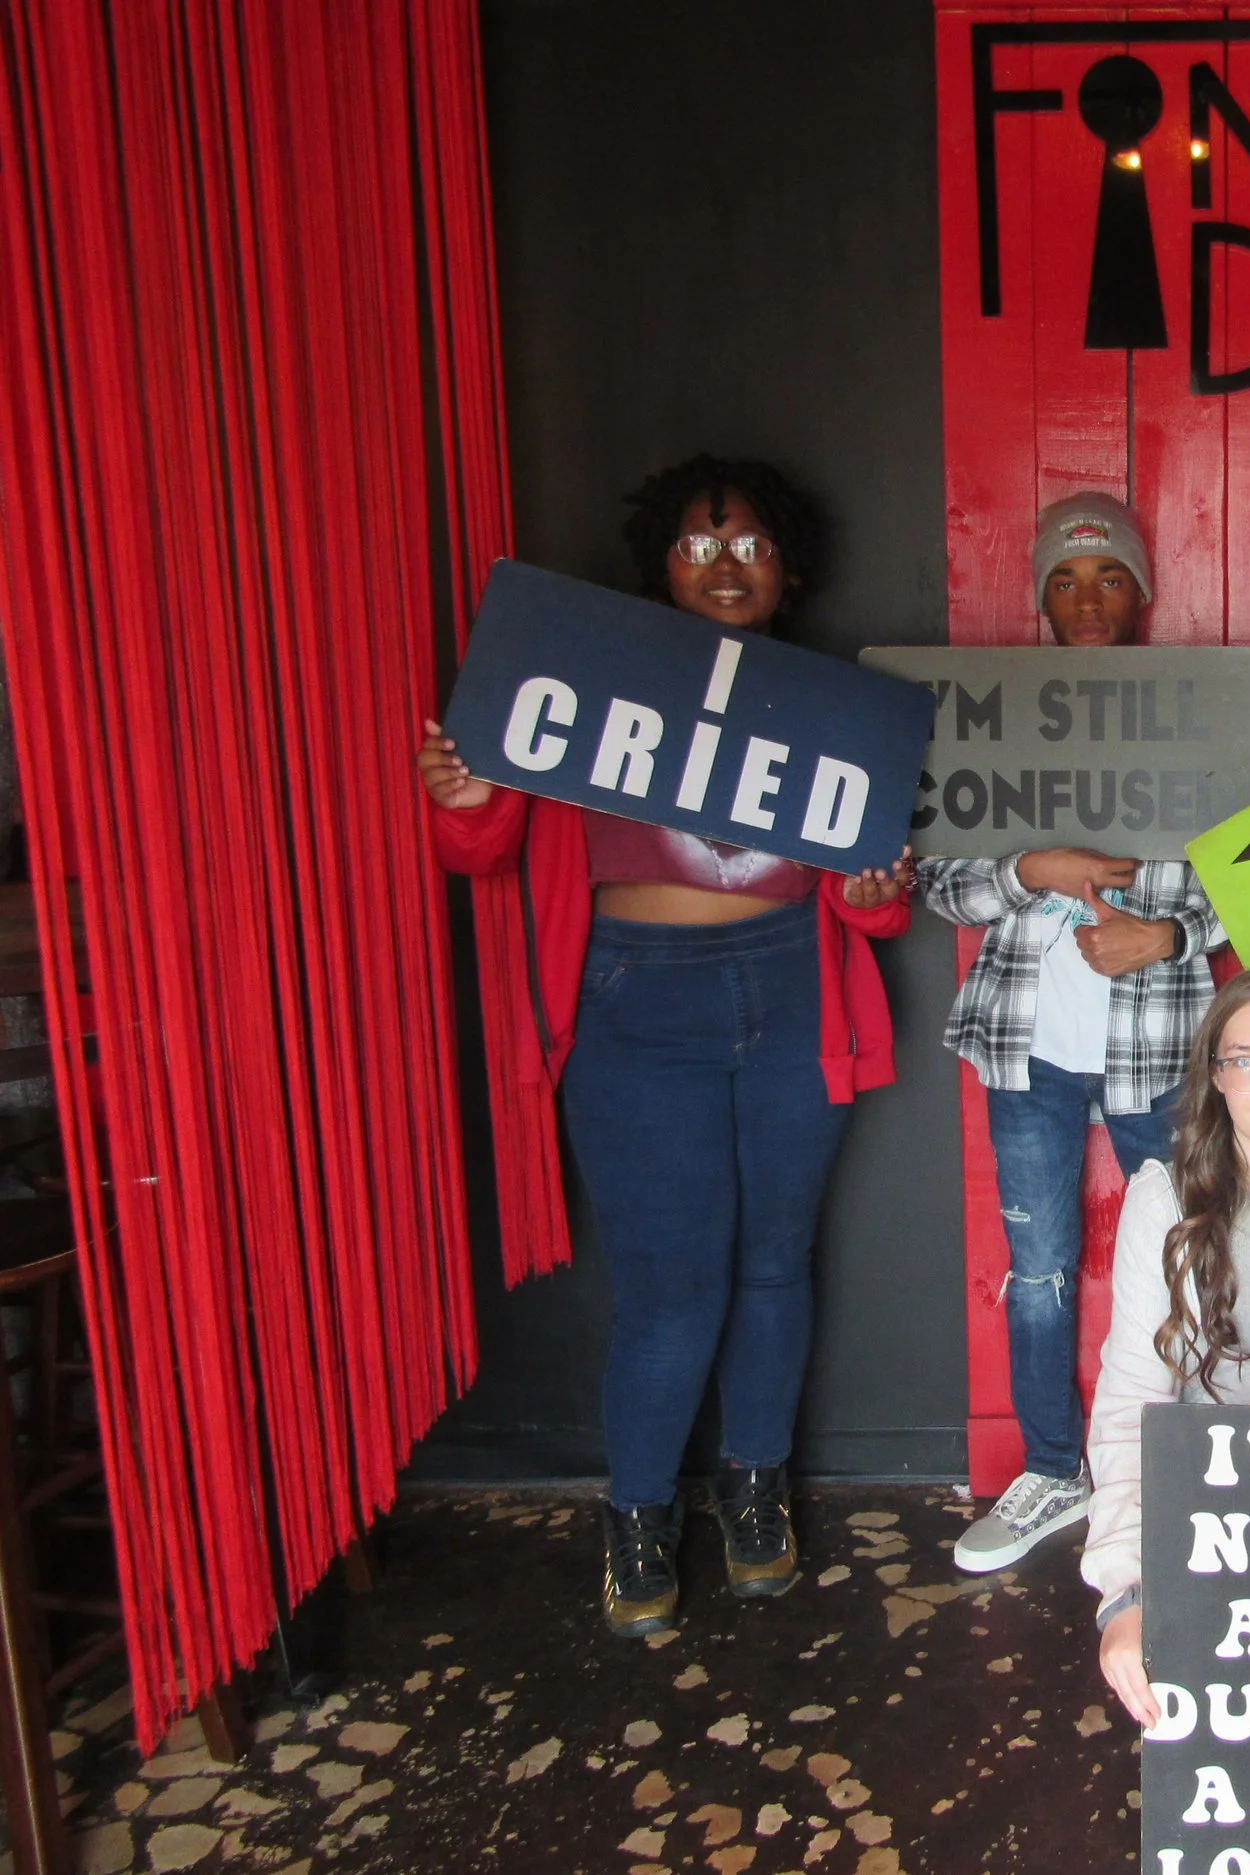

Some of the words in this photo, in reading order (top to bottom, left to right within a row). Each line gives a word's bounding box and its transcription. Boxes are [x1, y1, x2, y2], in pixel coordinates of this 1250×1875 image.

[703, 637, 743, 714] I
[919, 680, 1002, 741] 'M
[1038, 679, 1210, 742] STILL
[503, 677, 870, 849] CRIED
